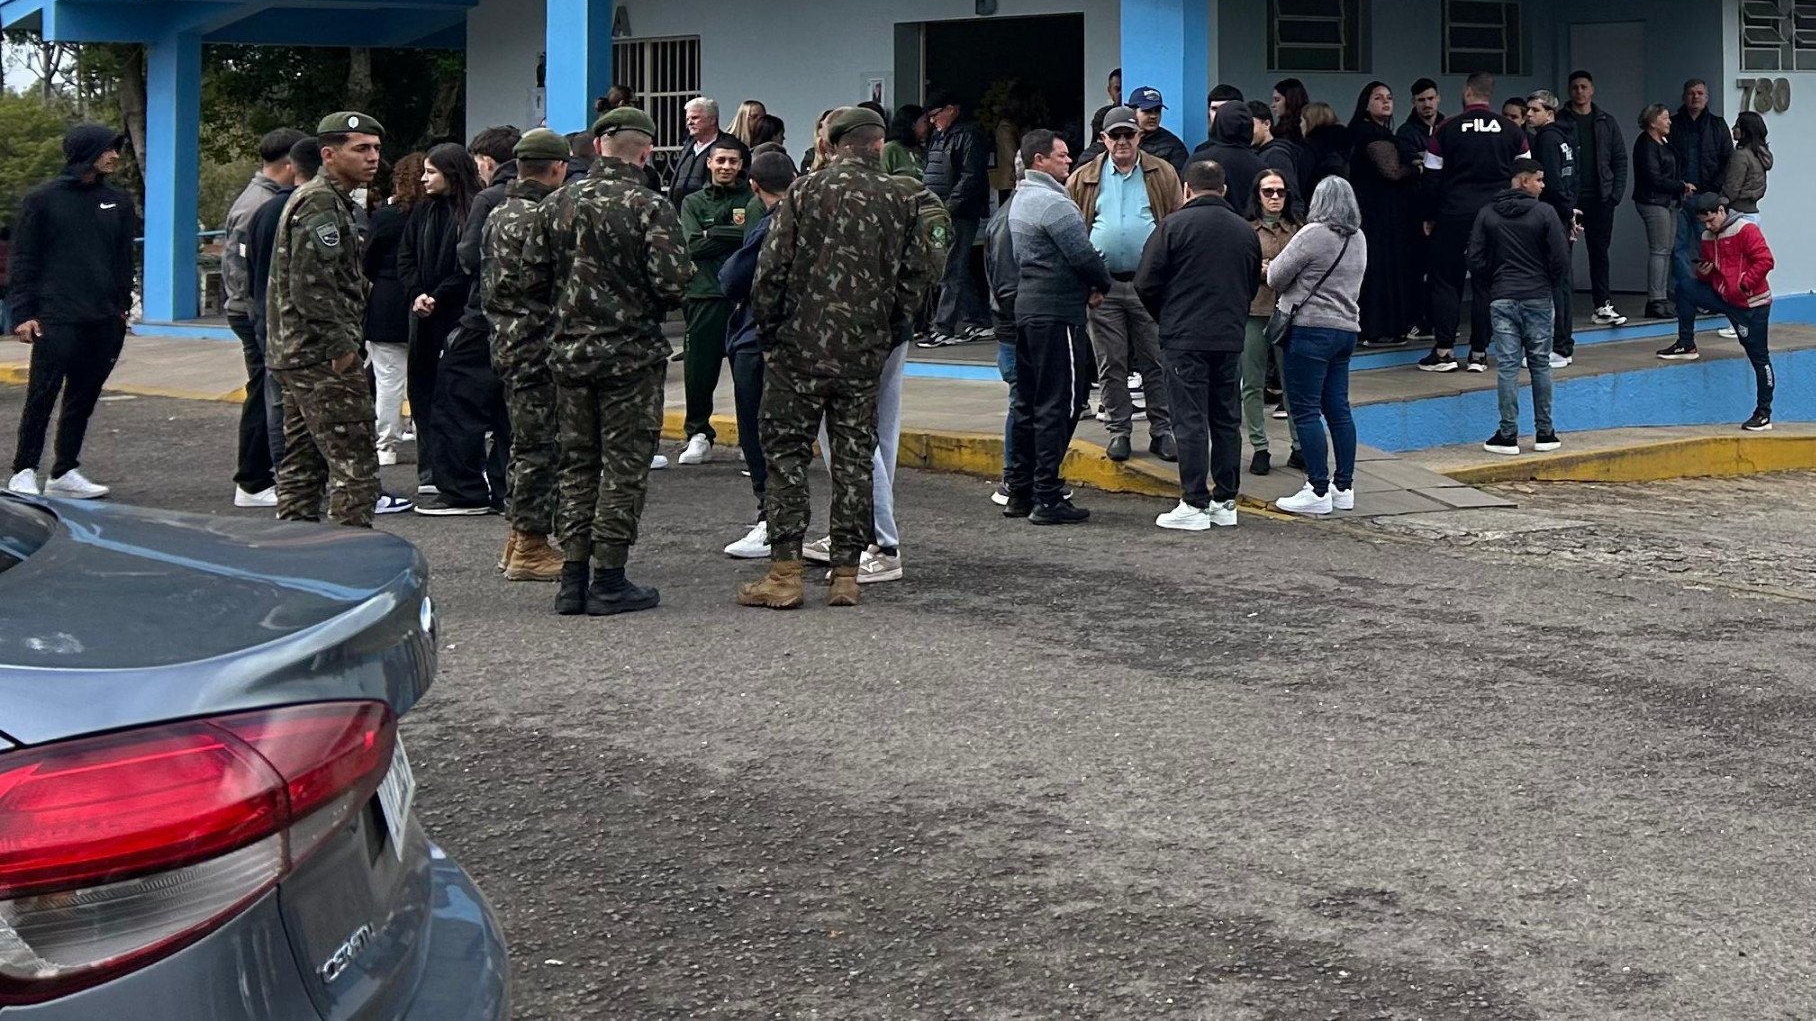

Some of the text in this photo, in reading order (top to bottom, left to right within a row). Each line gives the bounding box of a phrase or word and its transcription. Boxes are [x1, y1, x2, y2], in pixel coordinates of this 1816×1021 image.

[611, 5, 633, 37] A
[1736, 77, 1791, 114] 780
[1461, 118, 1502, 133] FILA
